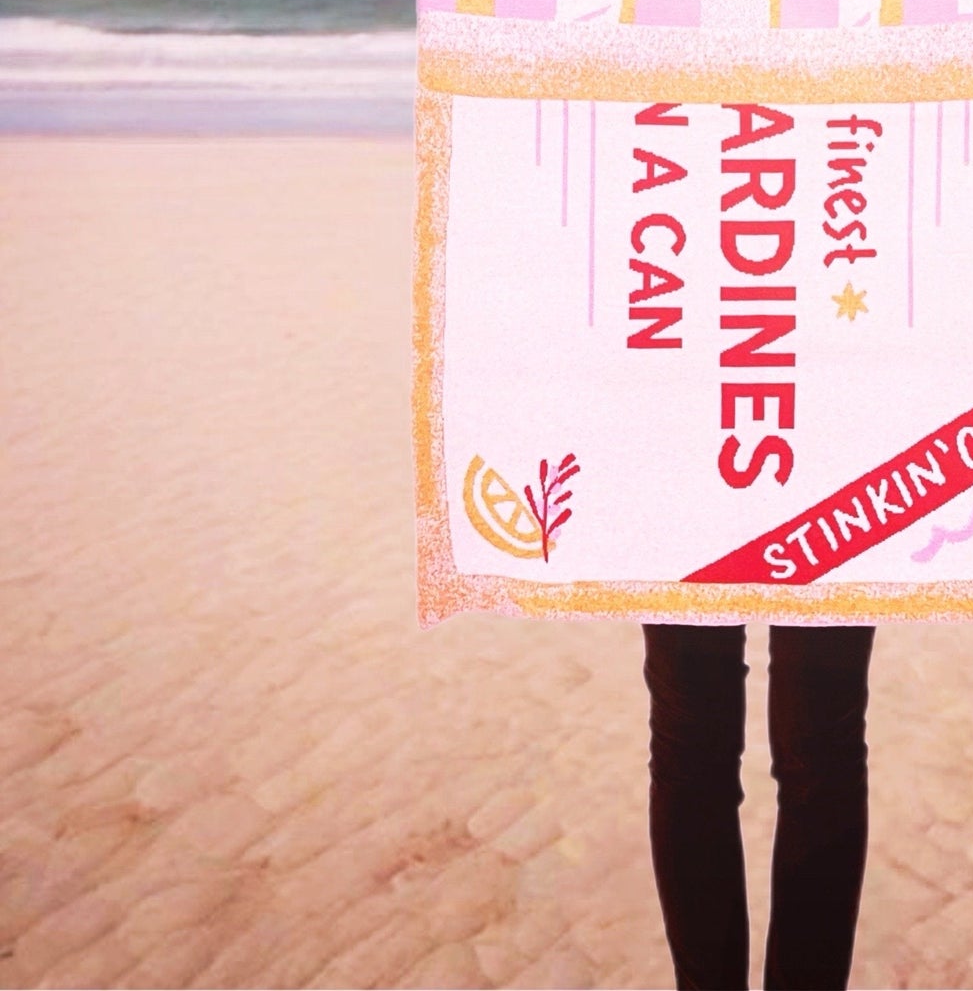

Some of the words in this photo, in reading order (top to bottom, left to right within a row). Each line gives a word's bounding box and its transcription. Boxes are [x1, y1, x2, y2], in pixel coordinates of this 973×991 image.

[631, 147, 689, 193] A
[821, 113, 883, 269] finest
[626, 212, 687, 349] CAN
[717, 103, 797, 490] ARDINES
